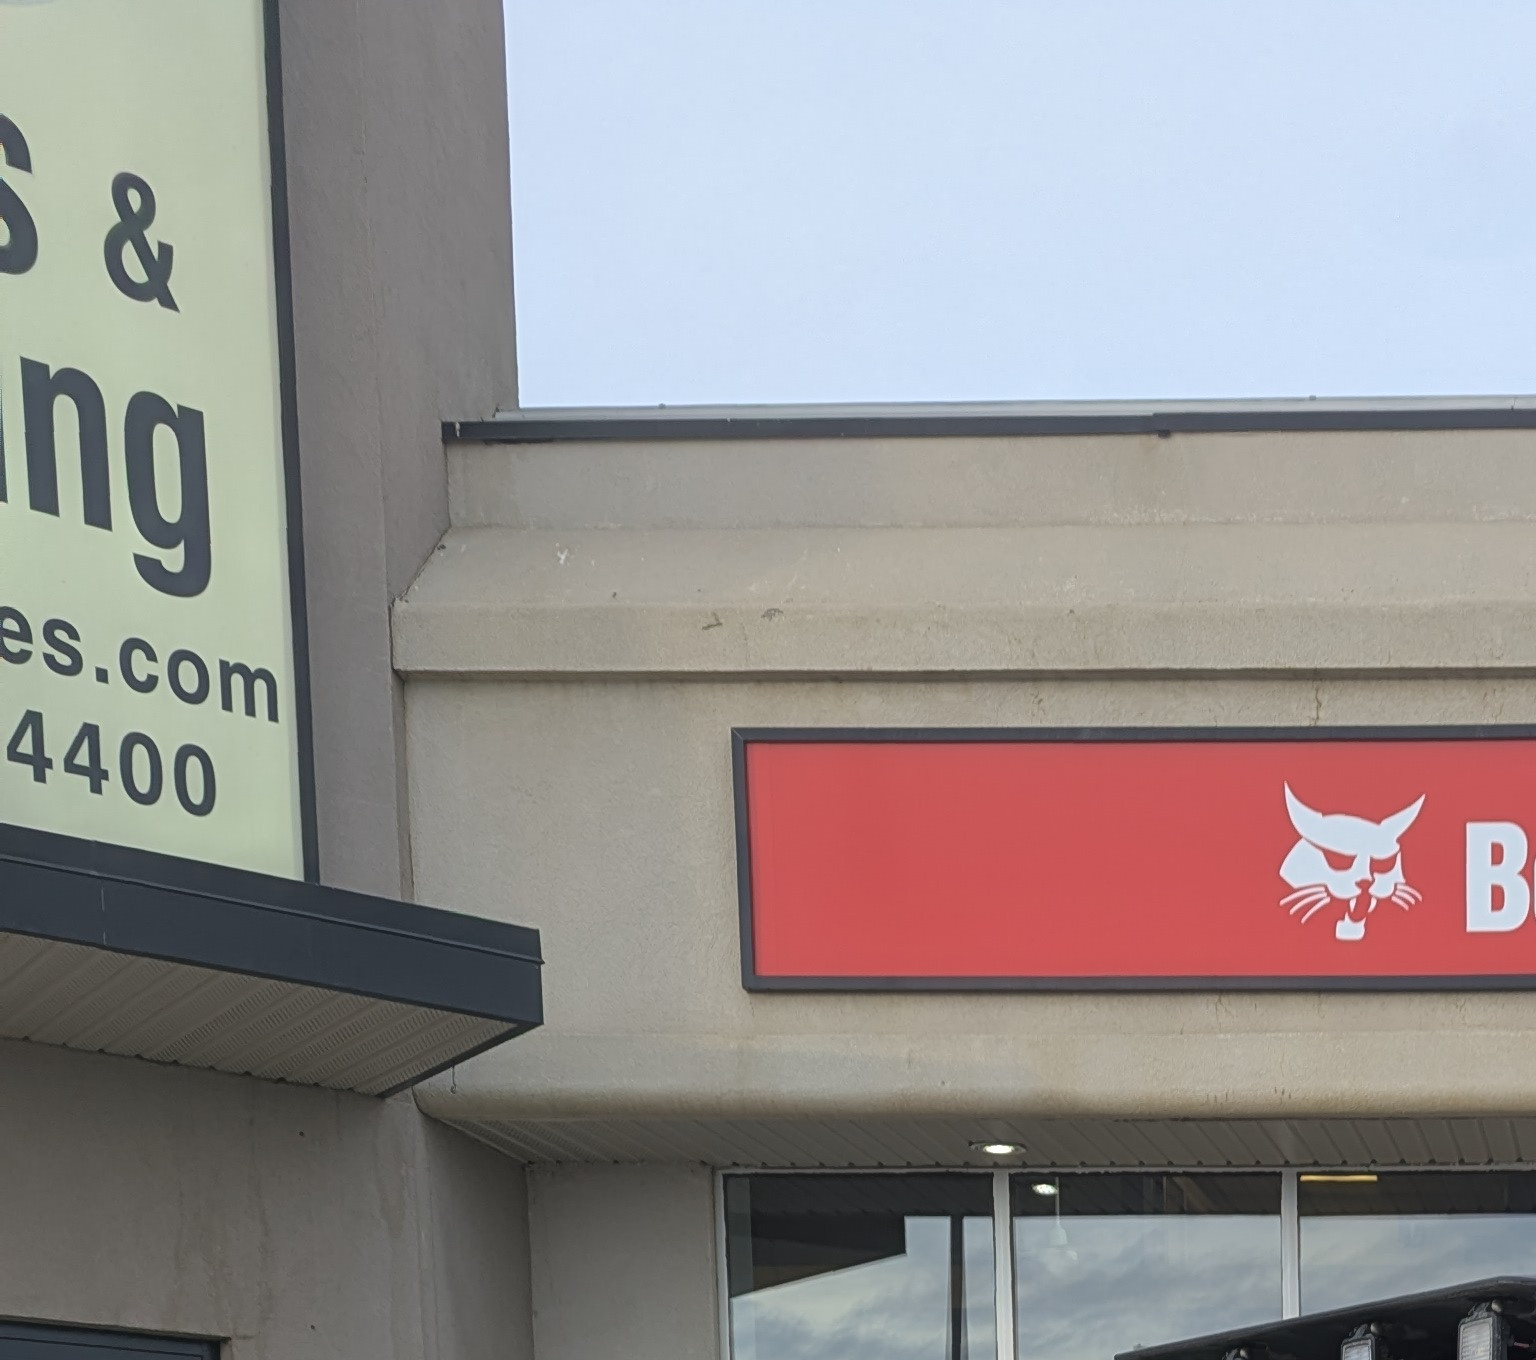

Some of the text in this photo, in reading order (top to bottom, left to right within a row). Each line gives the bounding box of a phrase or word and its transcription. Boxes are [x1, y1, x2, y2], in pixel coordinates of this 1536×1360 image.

[104, 172, 180, 313] &
[0, 356, 211, 597] ng
[0, 606, 279, 723] es.com
[6, 709, 217, 818] 4400
